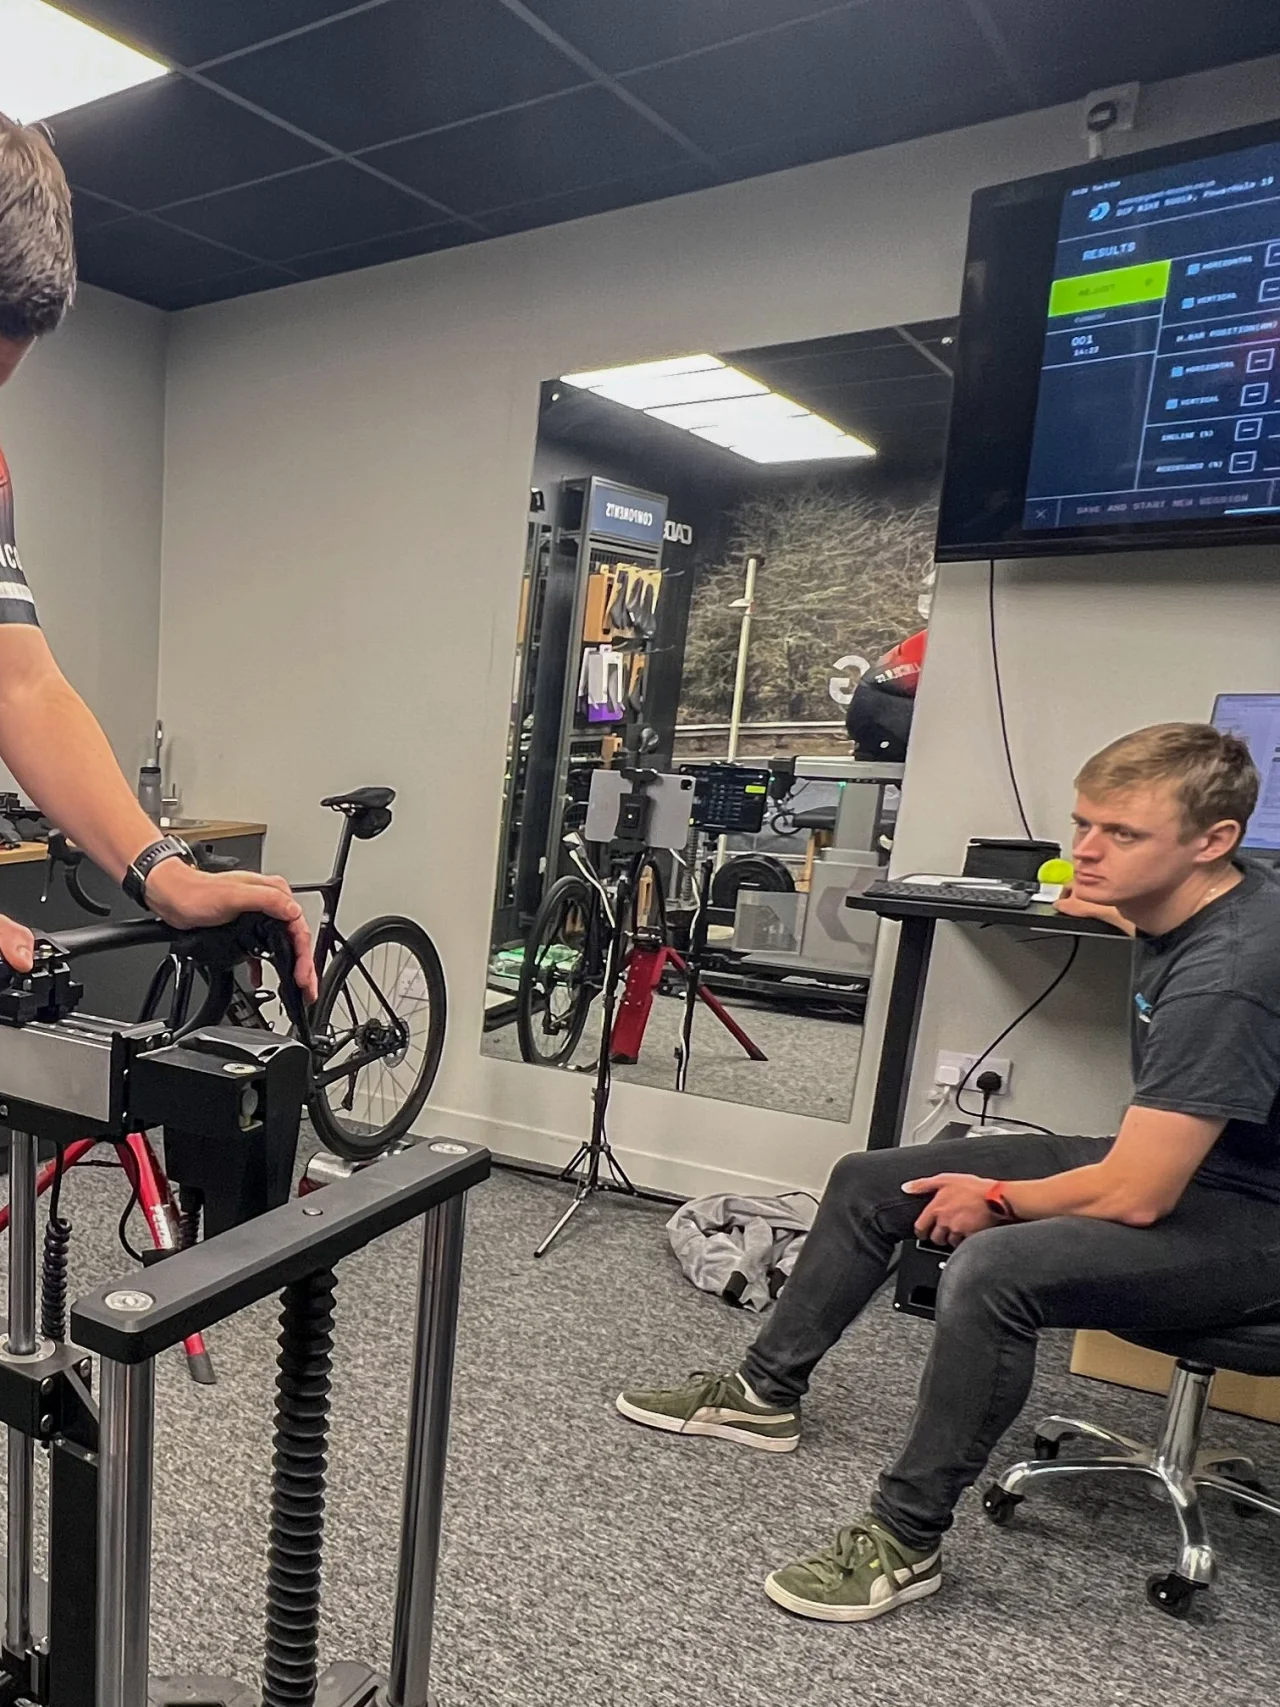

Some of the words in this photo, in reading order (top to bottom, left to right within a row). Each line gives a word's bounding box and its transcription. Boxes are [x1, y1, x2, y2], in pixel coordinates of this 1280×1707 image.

[1082, 242, 1136, 261] RESULTS
[1107, 502, 1127, 512] AND
[1133, 499, 1166, 511] START
